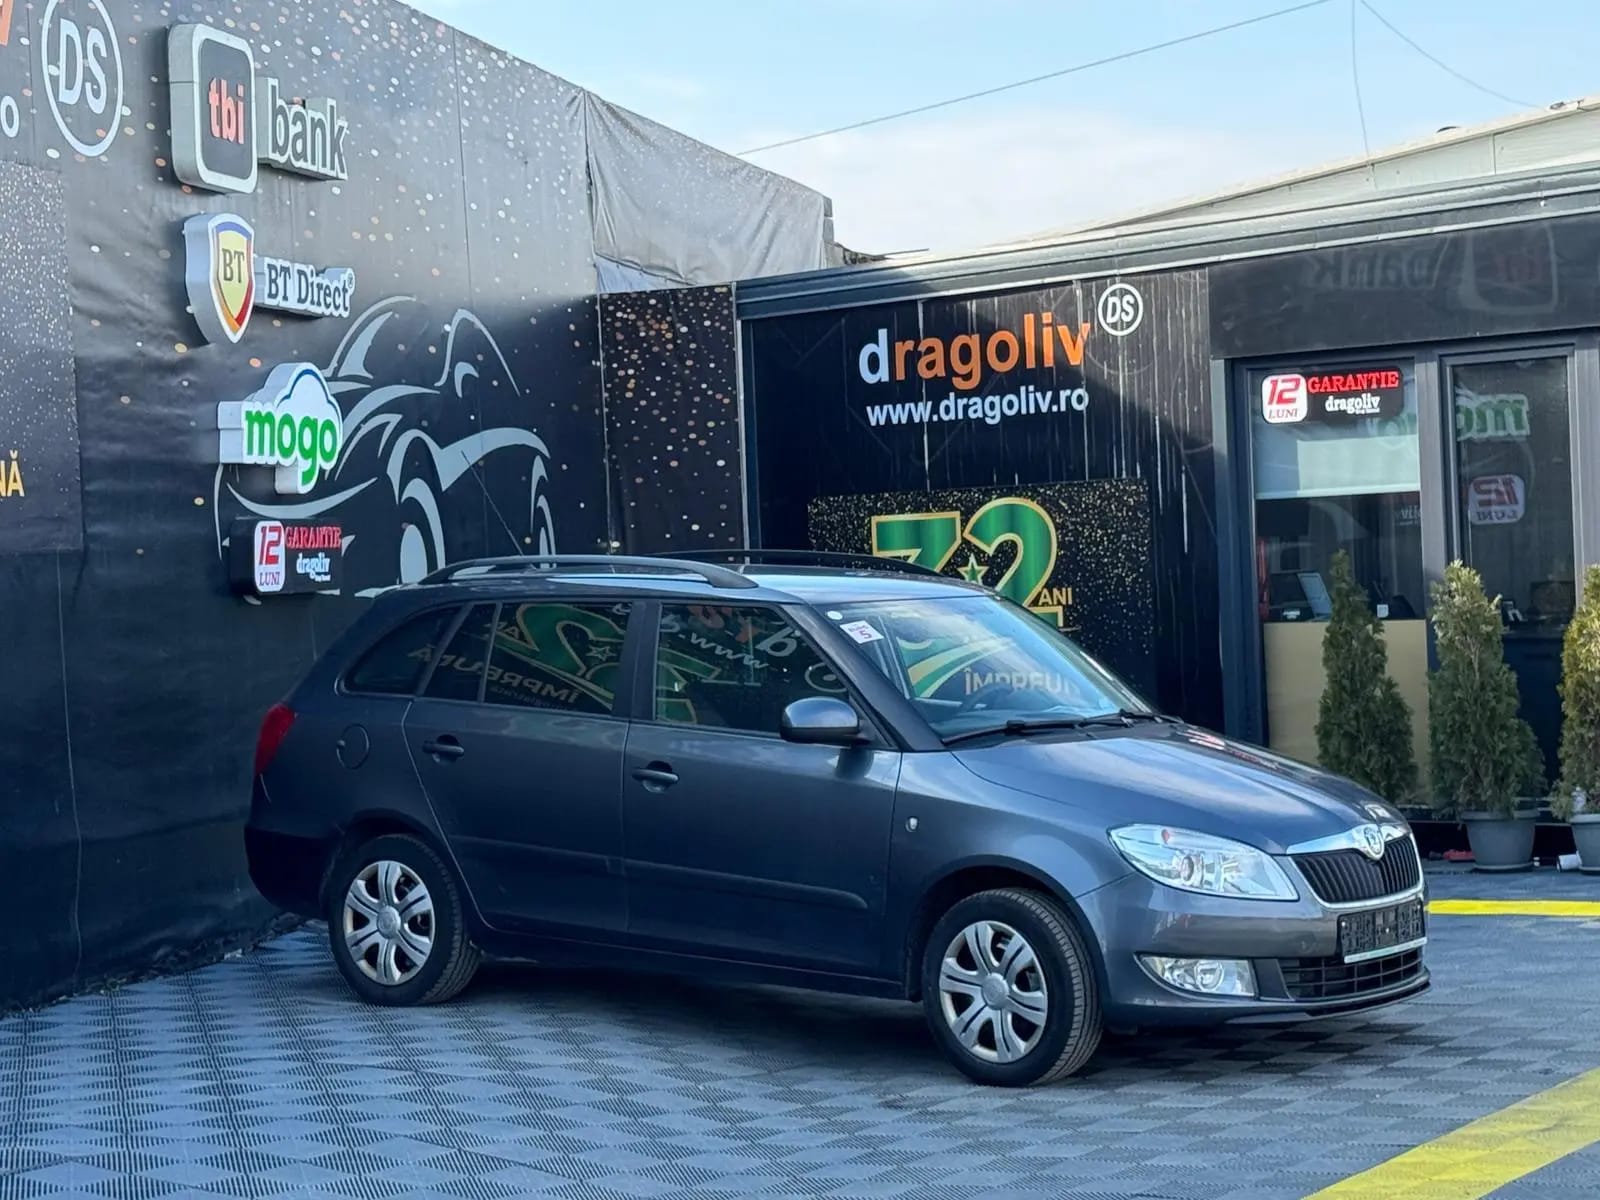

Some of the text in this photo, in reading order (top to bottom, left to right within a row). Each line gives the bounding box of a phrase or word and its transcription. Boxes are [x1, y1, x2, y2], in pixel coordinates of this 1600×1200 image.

[59, 18, 107, 114] DS
[208, 77, 347, 176] tbi bank
[222, 248, 244, 284] BT
[266, 263, 291, 301] BT
[1107, 295, 1134, 323] DS
[859, 311, 1091, 390] dragoliv
[866, 386, 1090, 426] www.dragoliv.ro
[1267, 371, 1399, 405] 12 GARANTIE
[1325, 393, 1380, 414] dragoliv
[1268, 409, 1298, 419] LUNI
[245, 409, 338, 486] mogo
[259, 526, 342, 565] 12 GARANTIE
[259, 572, 280, 586] LUNI
[296, 552, 331, 579] dragoliv
[1038, 587, 1073, 606] ANI
